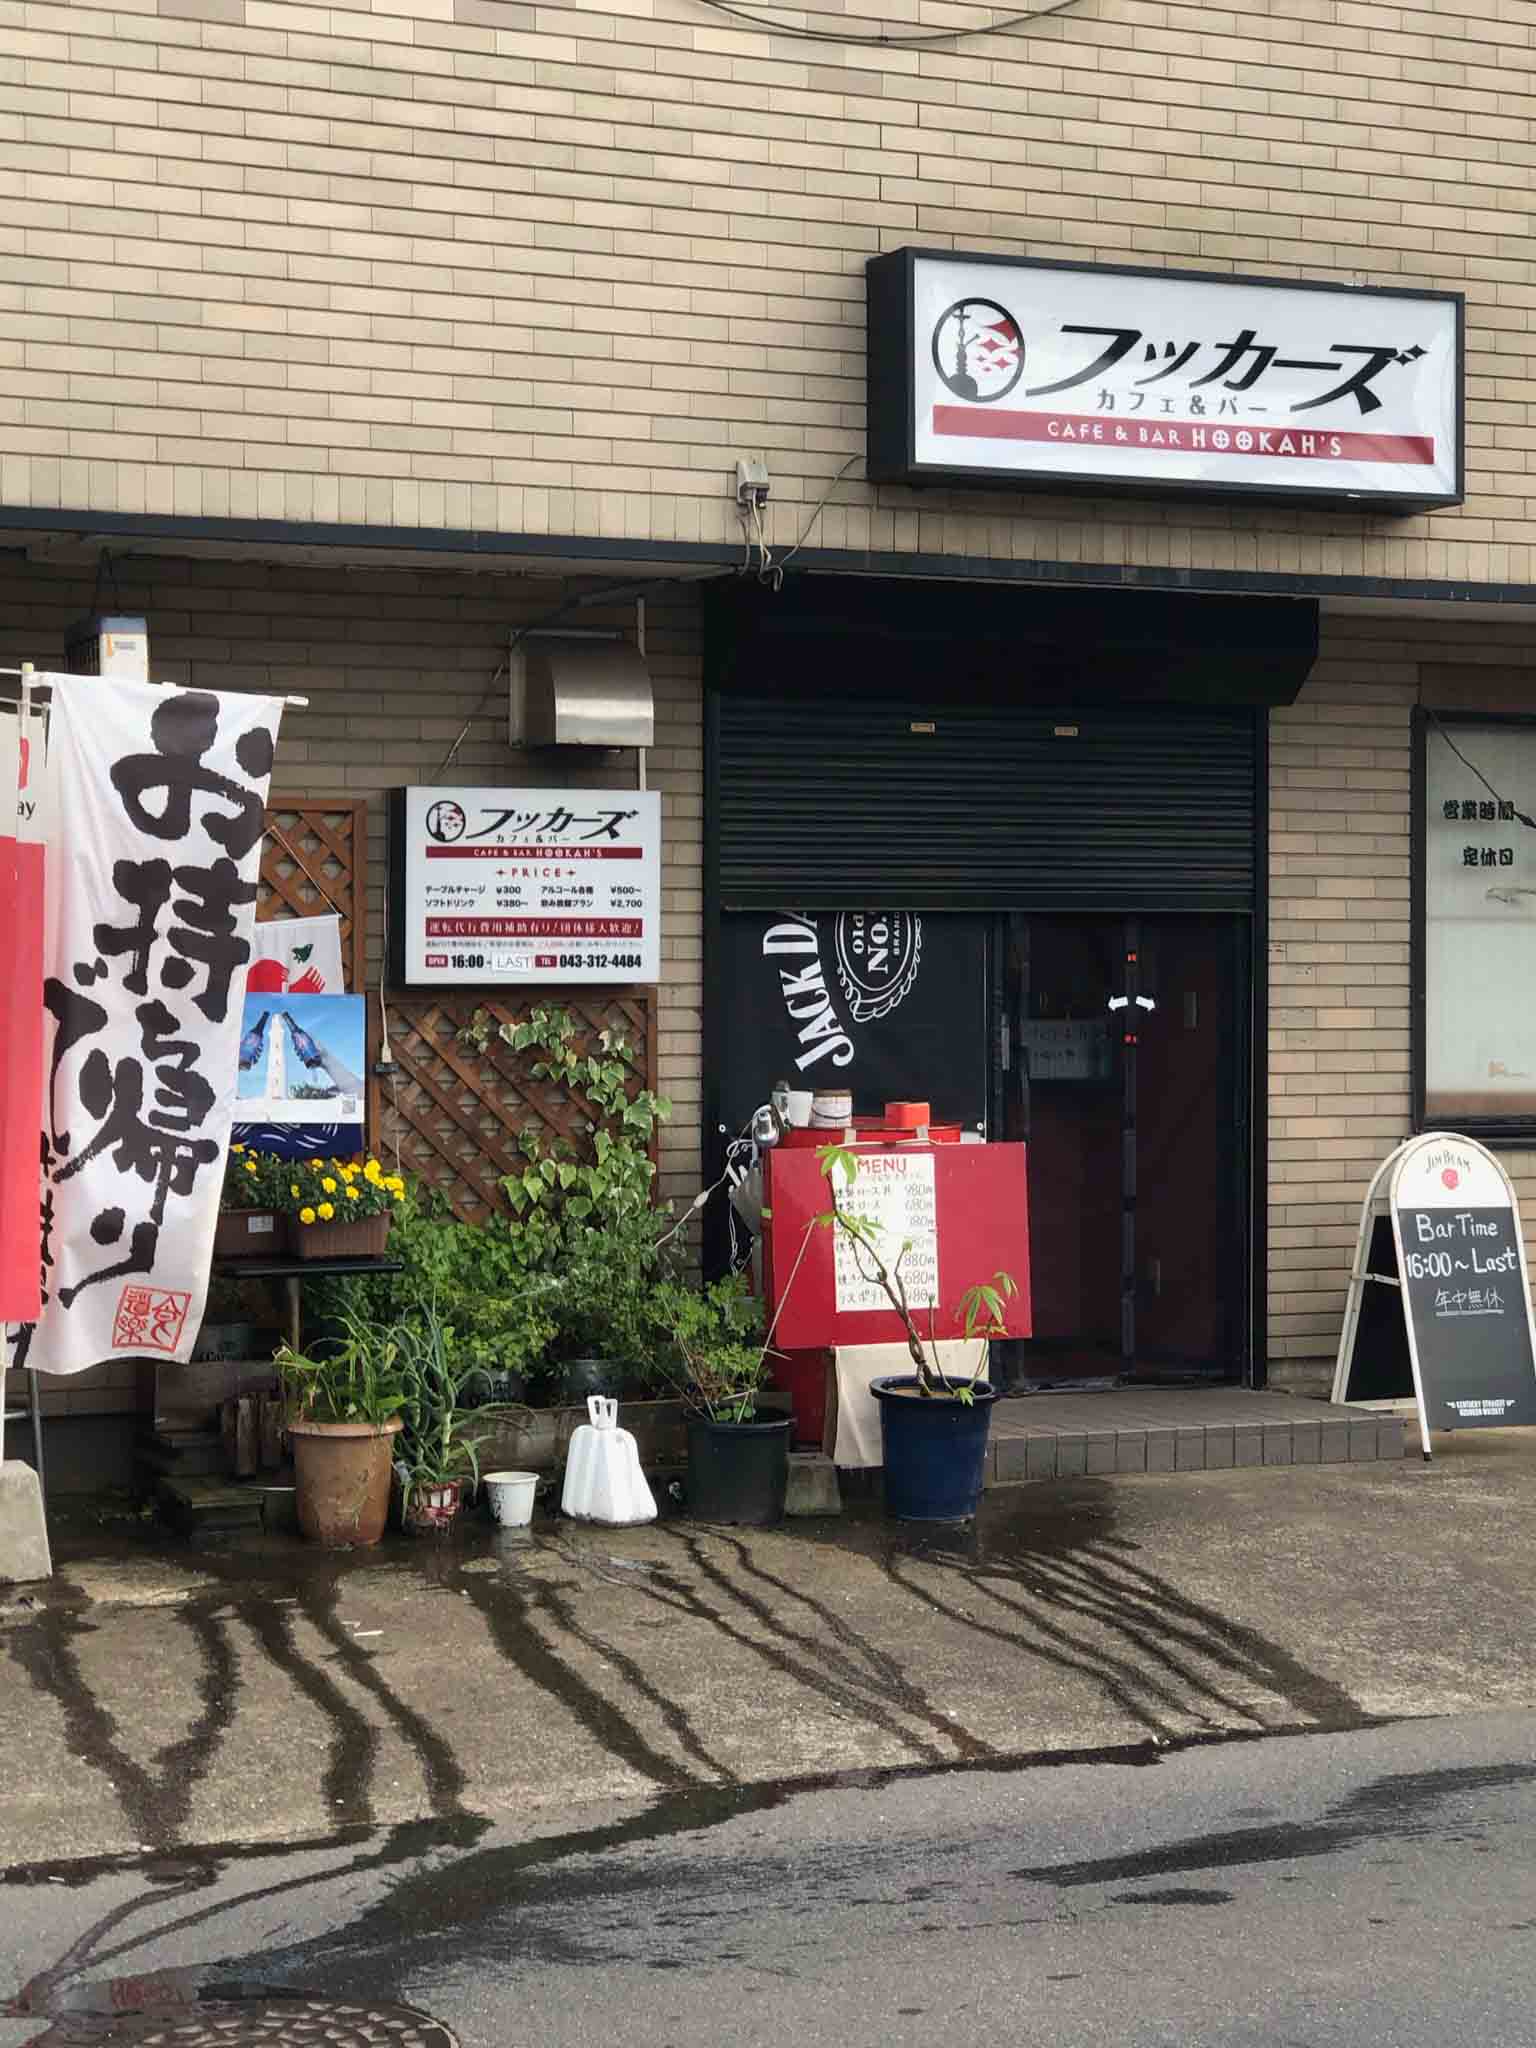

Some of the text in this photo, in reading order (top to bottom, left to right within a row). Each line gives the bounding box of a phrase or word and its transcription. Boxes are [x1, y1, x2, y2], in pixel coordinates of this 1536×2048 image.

[1026, 324, 1428, 415] フッカーズ
[1046, 420, 1342, 457] CAFE & BAR HOOKAH'S
[1443, 800, 1515, 821] 営業時間
[465, 807, 639, 841] フッカーズ
[473, 848, 499, 857] CAFE
[512, 848, 533, 857] BAR
[536, 848, 603, 858] HOOKAH'S
[1463, 845, 1514, 867] 定休日
[511, 867, 562, 878] PRICE
[425, 885, 486, 895] テーブルチャージ
[496, 885, 522, 895] ¥300
[425, 899, 475, 908] ソフトドリンク
[610, 899, 643, 908] ¥2,700
[497, 956, 529, 968] LAST
[560, 955, 642, 968] 043-312-4484
[779, 959, 855, 1072] JACK
[857, 1158, 907, 1175] MENU
[1416, 1212, 1498, 1241] Bar Time
[1434, 1286, 1505, 1313] 年中無休
